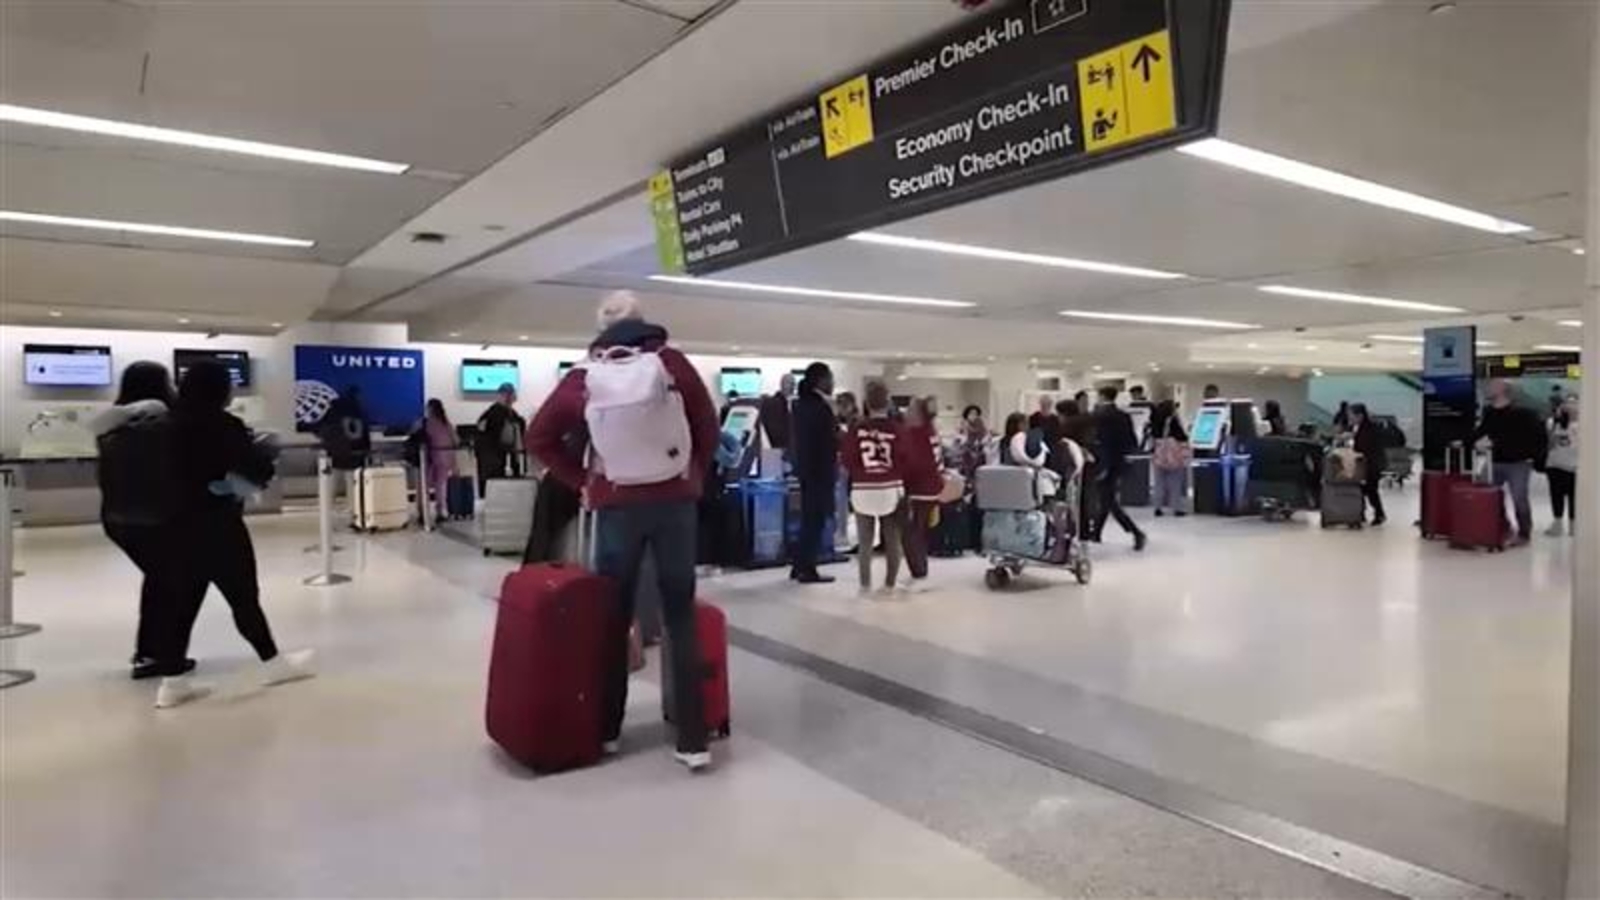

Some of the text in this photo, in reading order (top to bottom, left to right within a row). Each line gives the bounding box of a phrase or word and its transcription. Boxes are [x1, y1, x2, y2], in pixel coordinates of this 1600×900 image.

[874, 18, 1024, 97] Premier Check-In
[895, 83, 1070, 160] Economy Check-In
[888, 124, 1073, 199] Security Checkpoint
[332, 354, 417, 369] UNITED
[860, 440, 893, 468] 23
